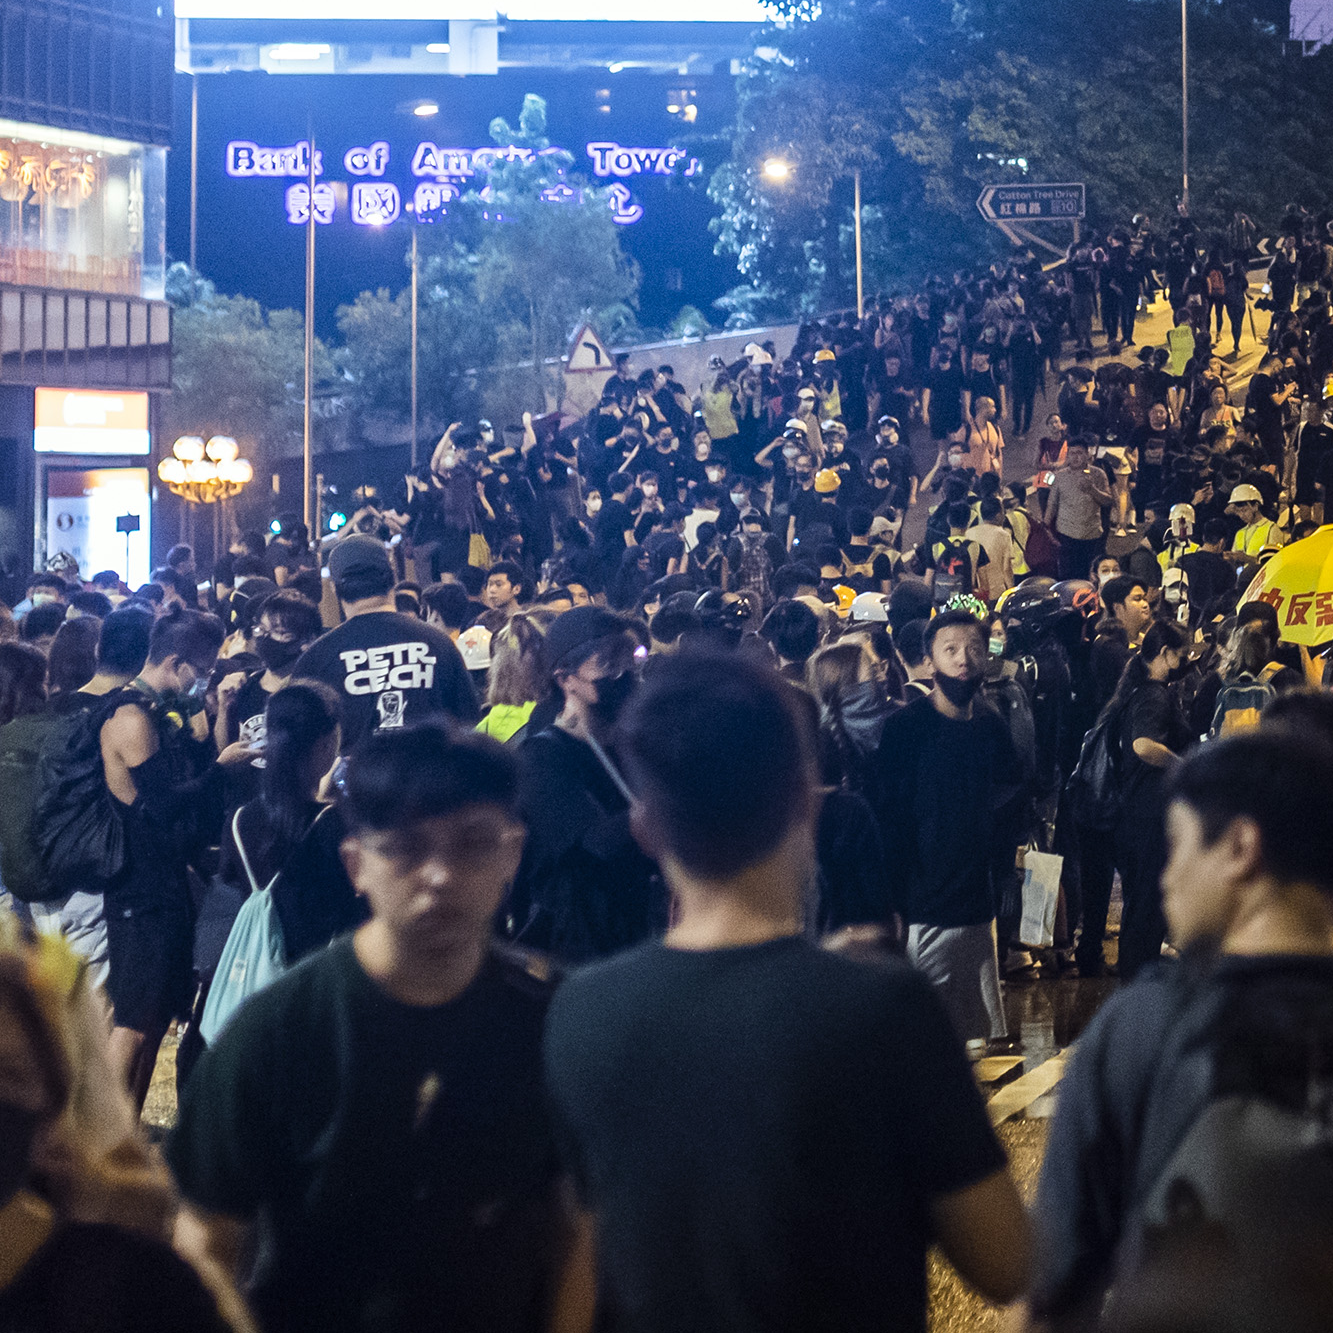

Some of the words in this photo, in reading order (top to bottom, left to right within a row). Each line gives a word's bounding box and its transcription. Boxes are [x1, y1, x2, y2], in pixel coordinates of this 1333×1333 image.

[226, 140, 324, 177] Bank
[344, 141, 391, 177] of
[340, 642, 437, 673] PETR
